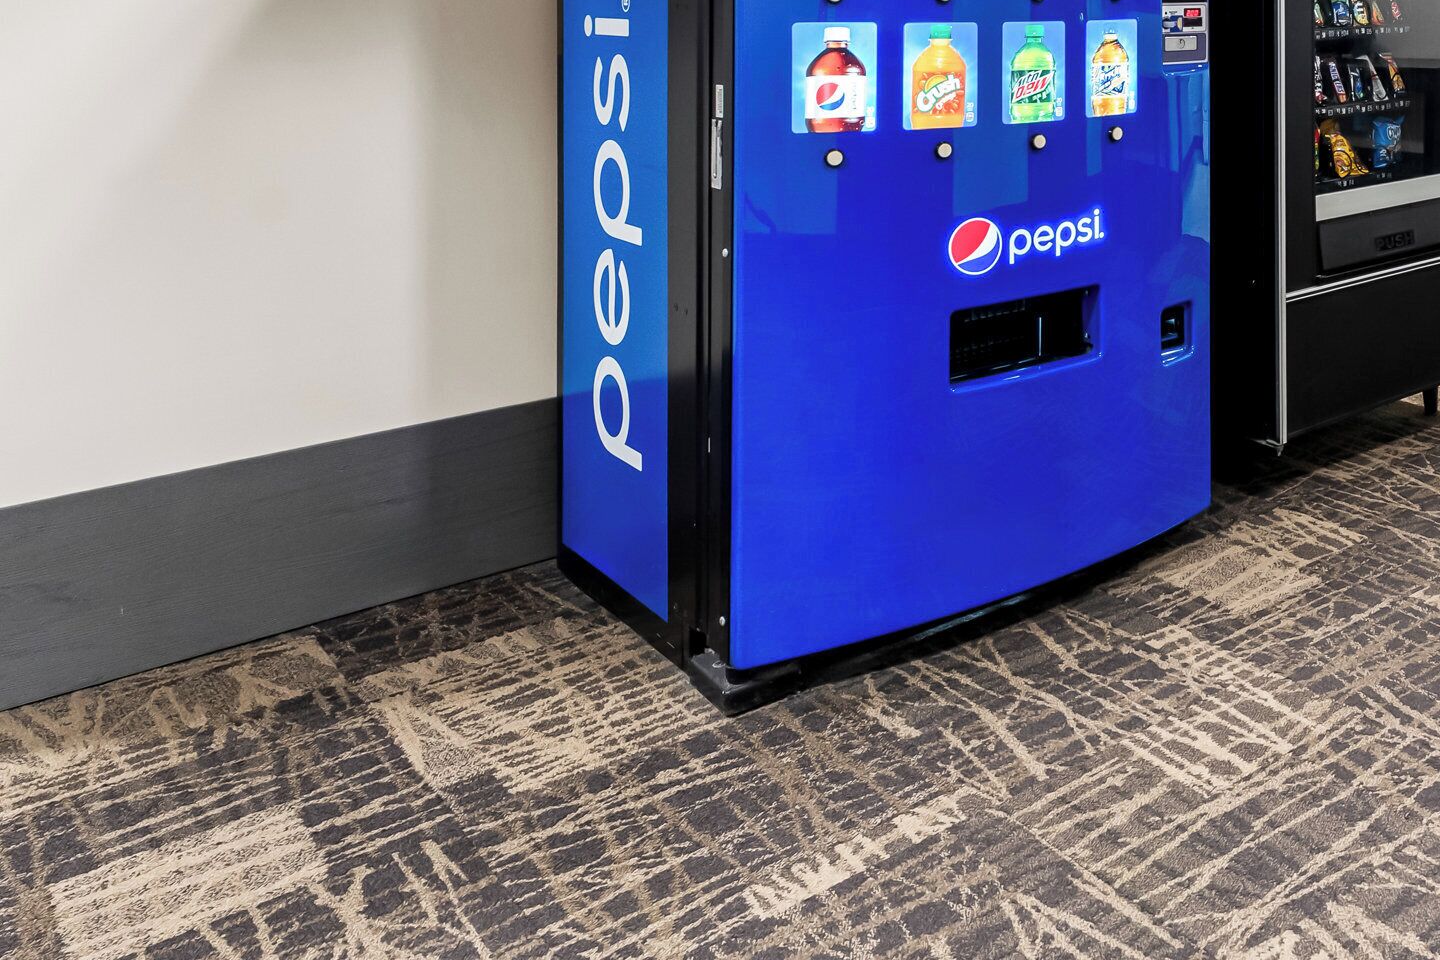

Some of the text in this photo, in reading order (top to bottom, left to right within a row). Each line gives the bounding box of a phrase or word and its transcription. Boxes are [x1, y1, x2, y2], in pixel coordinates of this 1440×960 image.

[916, 74, 961, 112] Crush
[584, 14, 642, 472] pepsi
[1008, 208, 1105, 265] pepsi
[1376, 230, 1415, 251] PUSH
